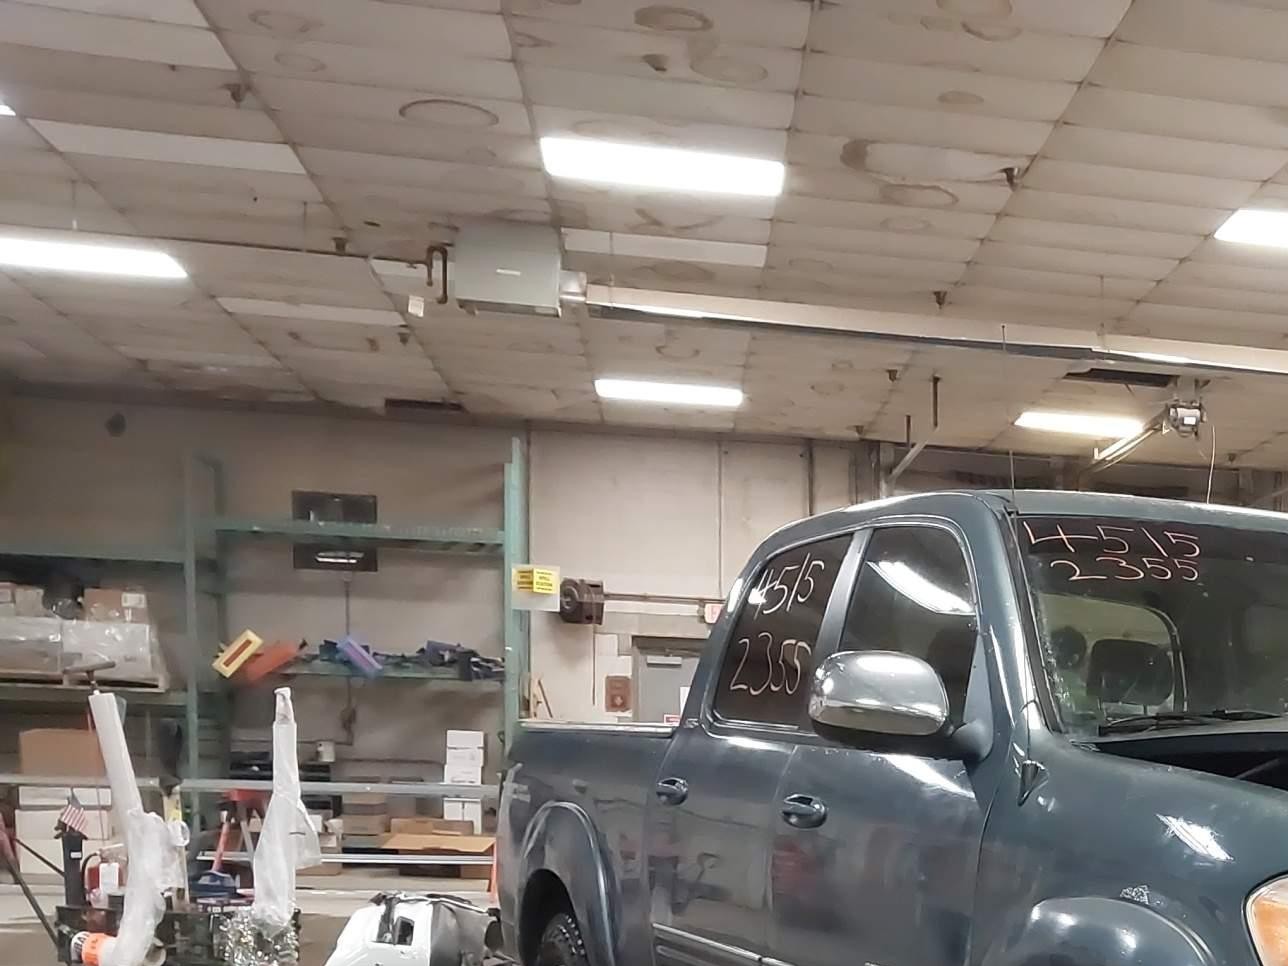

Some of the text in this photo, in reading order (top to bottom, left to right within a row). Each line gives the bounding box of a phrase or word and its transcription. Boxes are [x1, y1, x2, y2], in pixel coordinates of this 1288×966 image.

[1023, 520, 1201, 558] 4515
[751, 552, 825, 621] 4515
[1049, 556, 1199, 582] 2355
[729, 631, 812, 696] 2355
